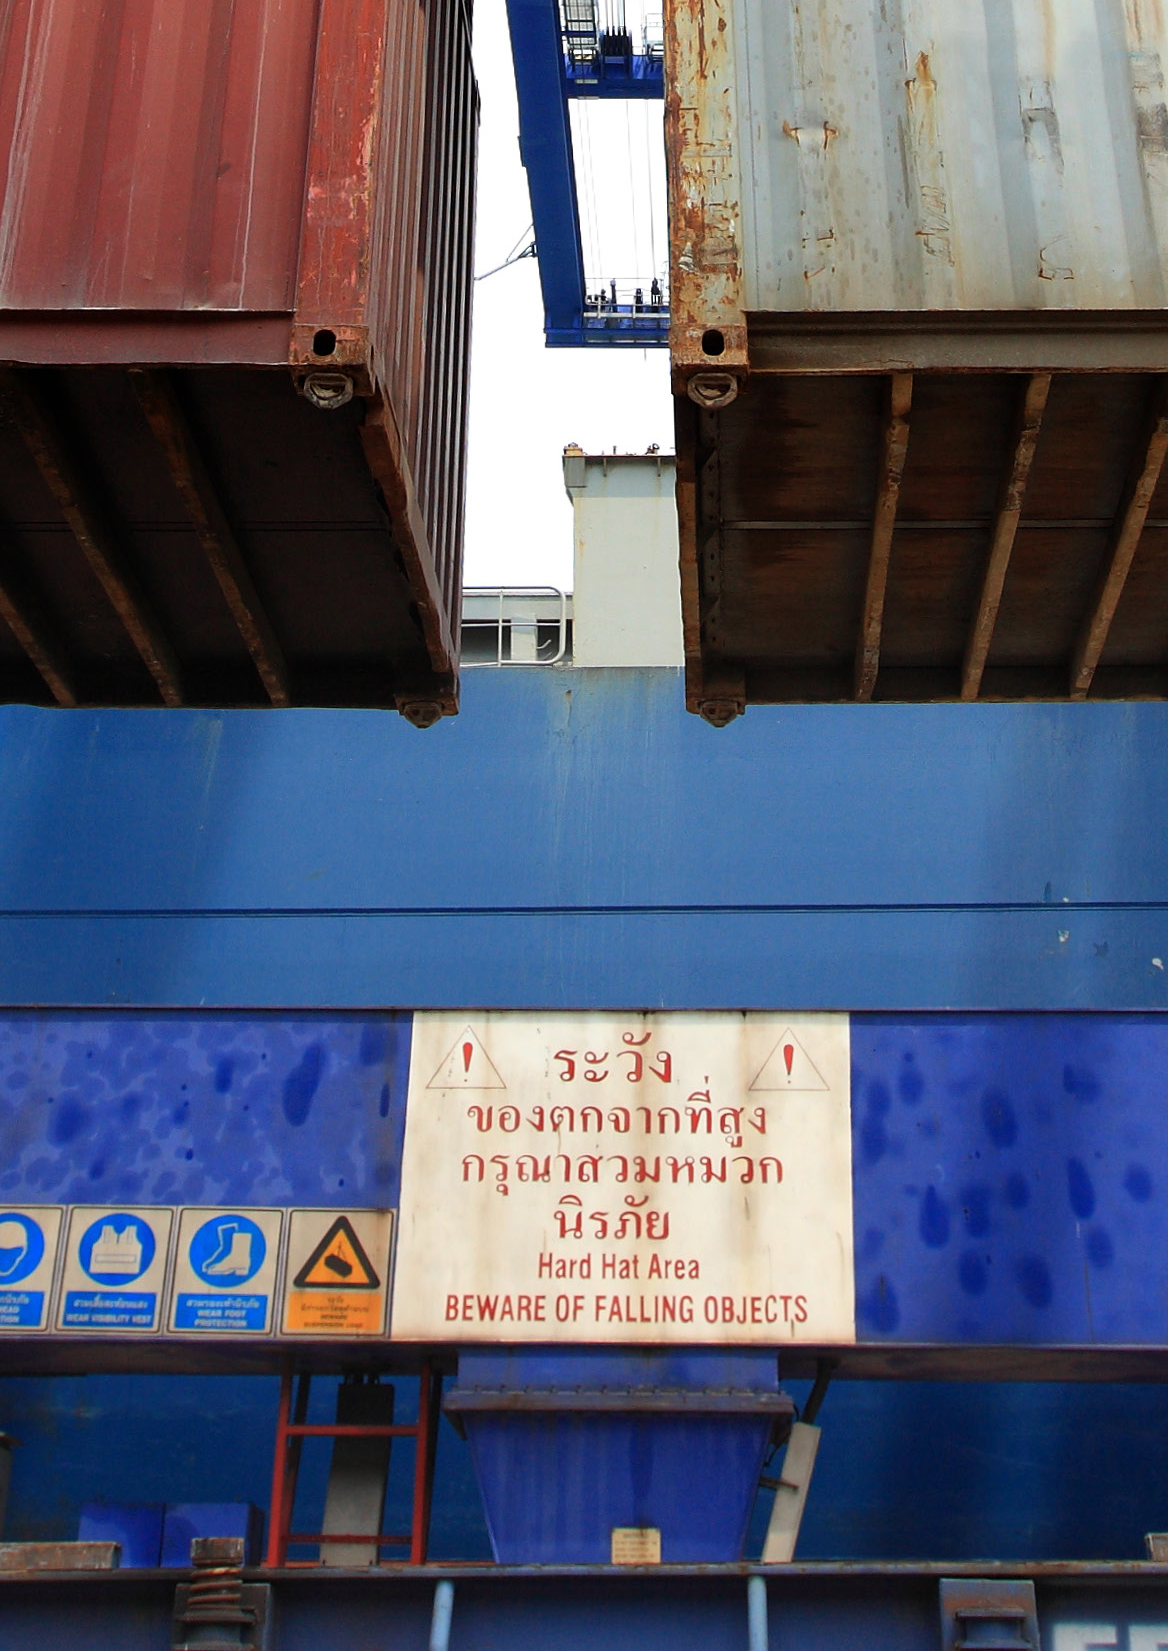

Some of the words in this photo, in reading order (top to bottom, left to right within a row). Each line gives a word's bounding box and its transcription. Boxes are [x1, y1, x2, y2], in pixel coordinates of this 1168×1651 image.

[555, 1032, 672, 1083] ระวัง
[467, 1075, 767, 1147] ของตกจากที่สูง
[462, 1154, 784, 1196] กรุณาสวมหมวก
[554, 1195, 670, 1240] นิรภัย
[538, 1253, 592, 1279] Hard
[601, 1254, 639, 1279] Hat
[648, 1253, 700, 1280] Area
[194, 1318, 248, 1328] PROTECTION
[197, 1309, 222, 1318] WEAR
[225, 1310, 247, 1318] FOOT
[445, 1294, 546, 1321] BEWARE
[555, 1294, 585, 1322] OF
[594, 1294, 694, 1323] FALLING
[703, 1294, 808, 1324] OBJECTS
